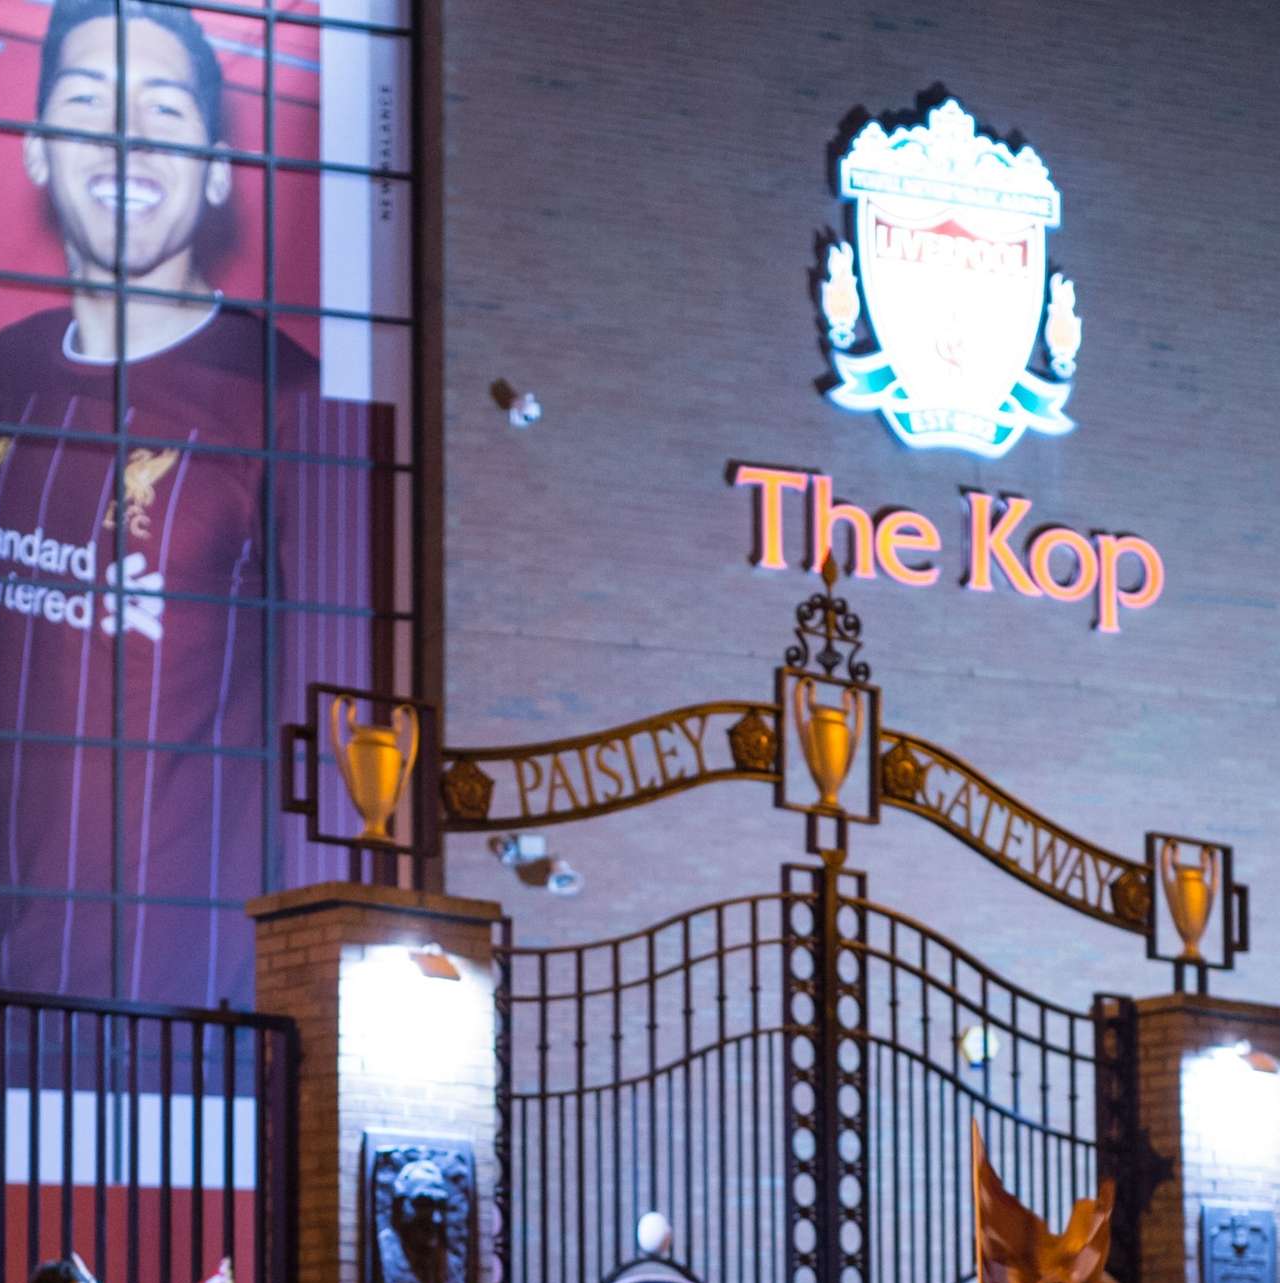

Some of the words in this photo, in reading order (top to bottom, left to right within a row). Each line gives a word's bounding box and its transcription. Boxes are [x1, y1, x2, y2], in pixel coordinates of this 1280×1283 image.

[734, 465, 941, 586] The
[967, 491, 1165, 634] Kop
[513, 712, 710, 820] PAISLEY
[918, 757, 1118, 912] GATEWAY
